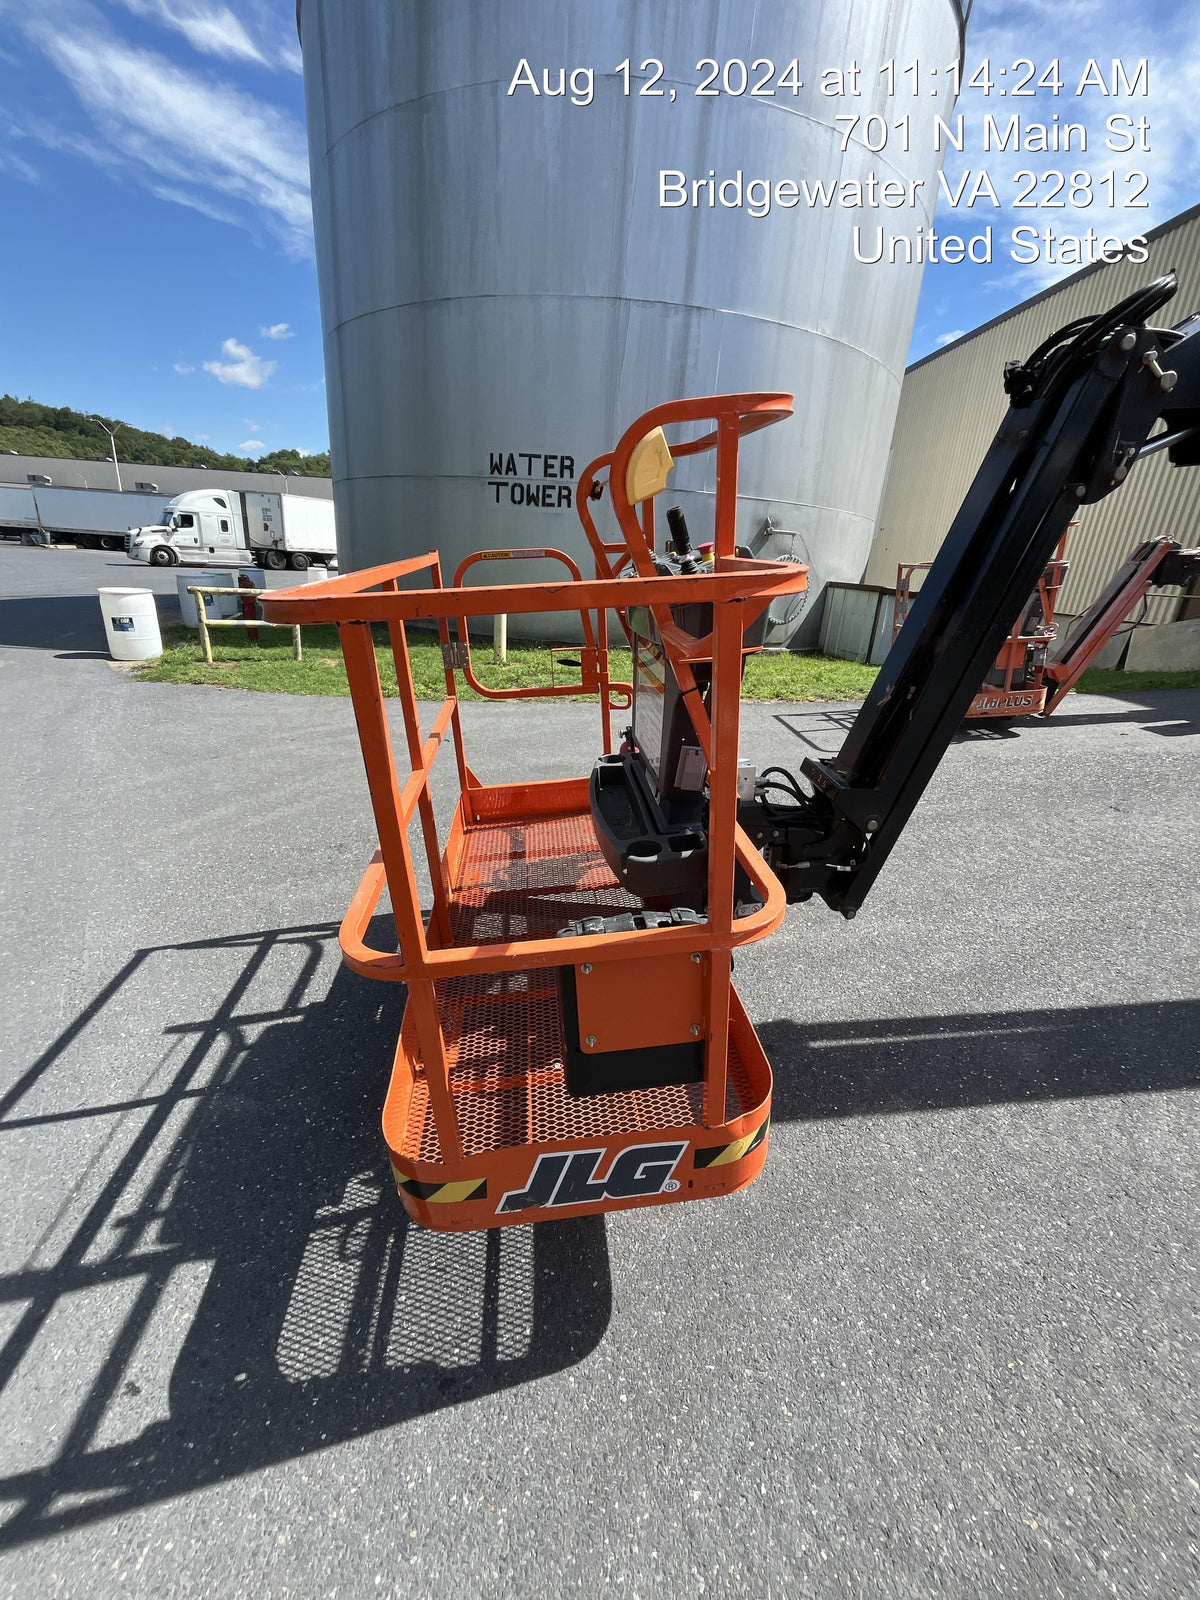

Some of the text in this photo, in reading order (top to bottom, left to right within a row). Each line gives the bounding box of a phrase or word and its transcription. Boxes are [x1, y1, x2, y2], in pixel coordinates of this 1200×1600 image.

[490, 452, 575, 479] WATER
[488, 481, 572, 508] TOWER
[495, 1140, 690, 1214] JLG
